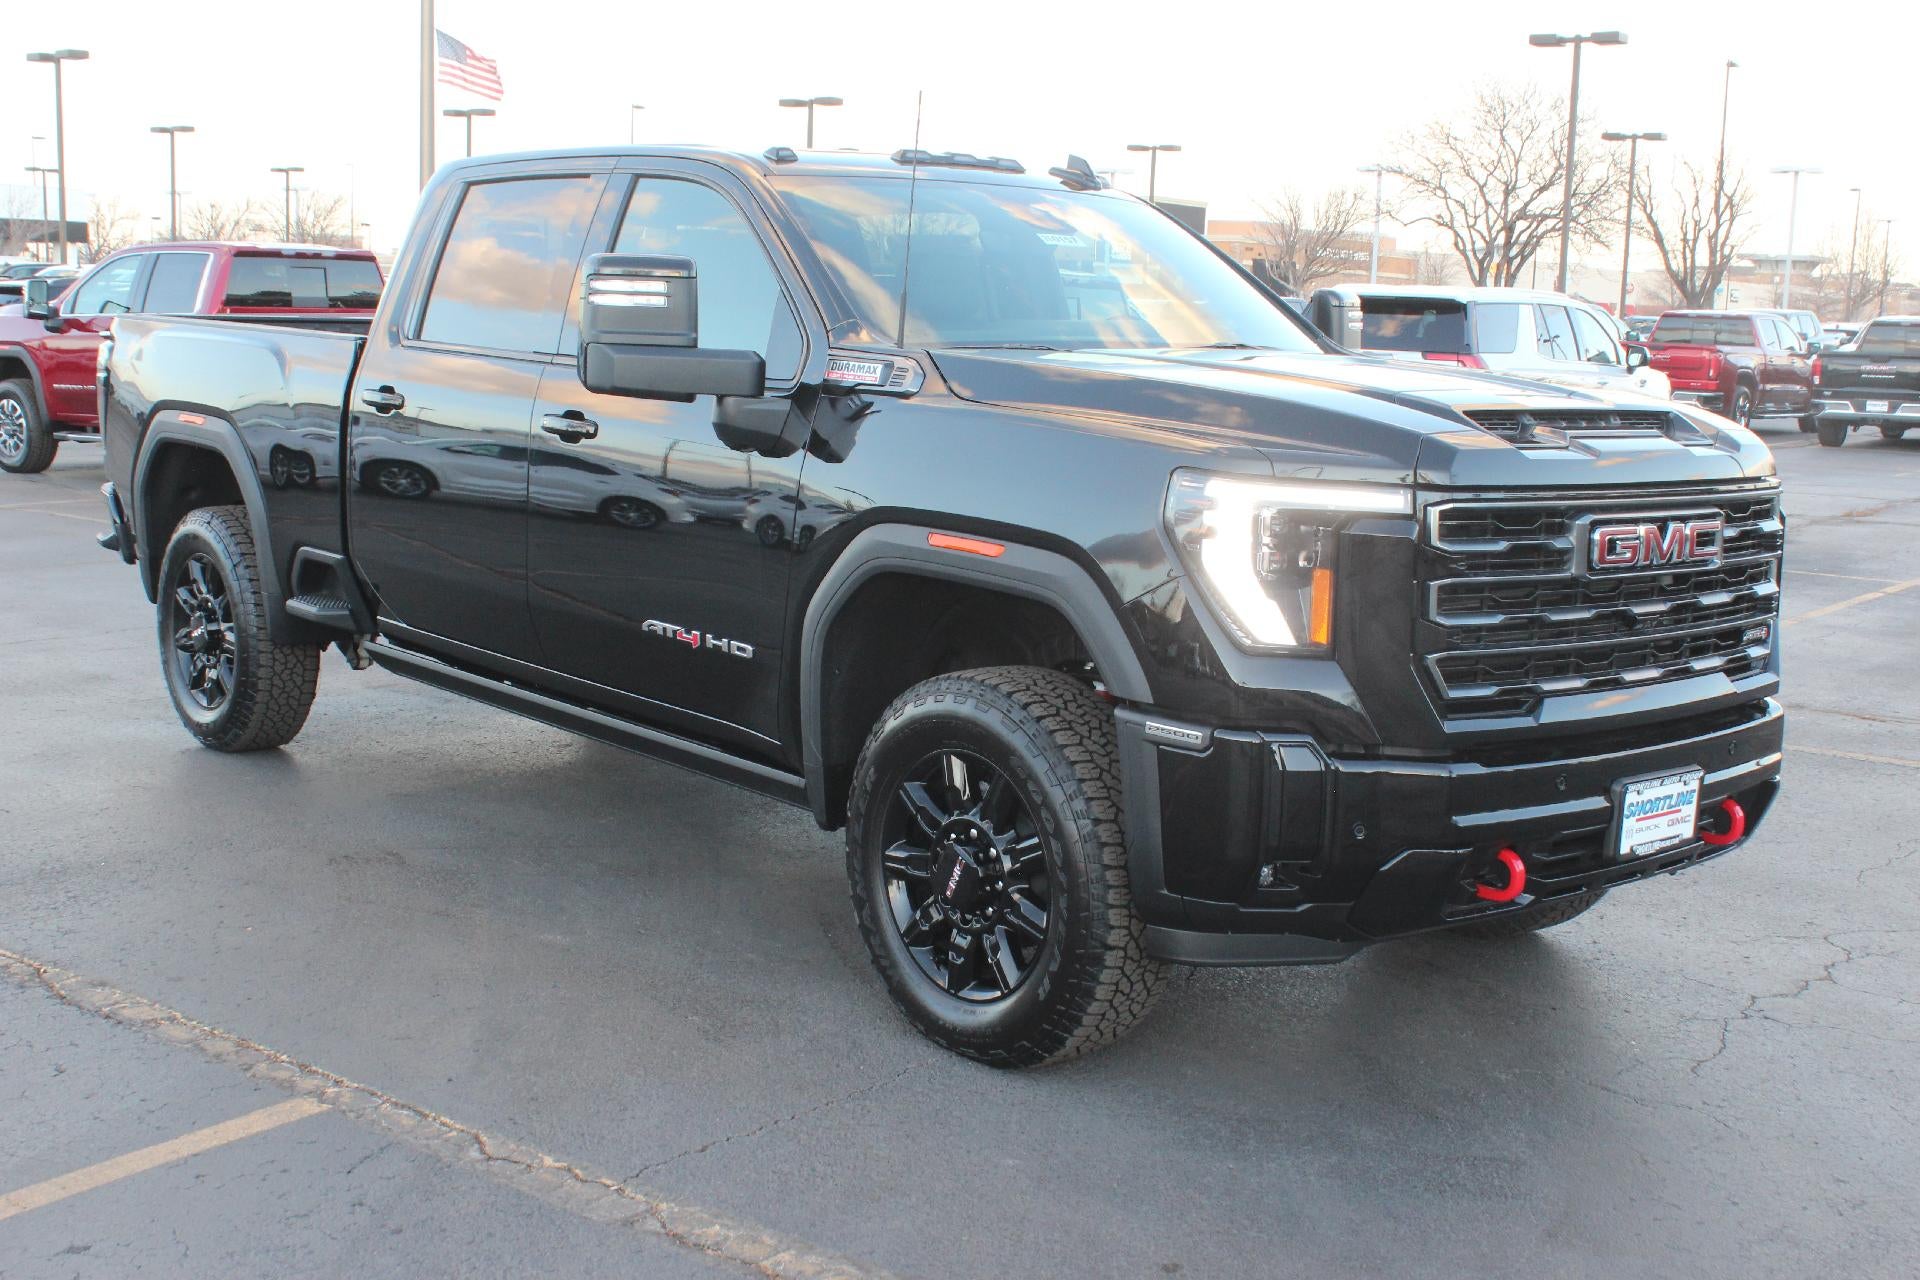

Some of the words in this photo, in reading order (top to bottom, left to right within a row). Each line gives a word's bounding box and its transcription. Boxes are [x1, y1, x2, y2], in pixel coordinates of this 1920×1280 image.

[831, 361, 878, 375] DURAMAX
[1593, 521, 1722, 569] GMC
[641, 619, 700, 648] AT4
[706, 633, 753, 658] HD
[1147, 724, 1200, 741] 2500
[1624, 789, 1696, 819] SHORTLINE
[1635, 823, 1661, 834] BUICK
[1667, 814, 1692, 828] GMC
[945, 856, 966, 898] GMC
